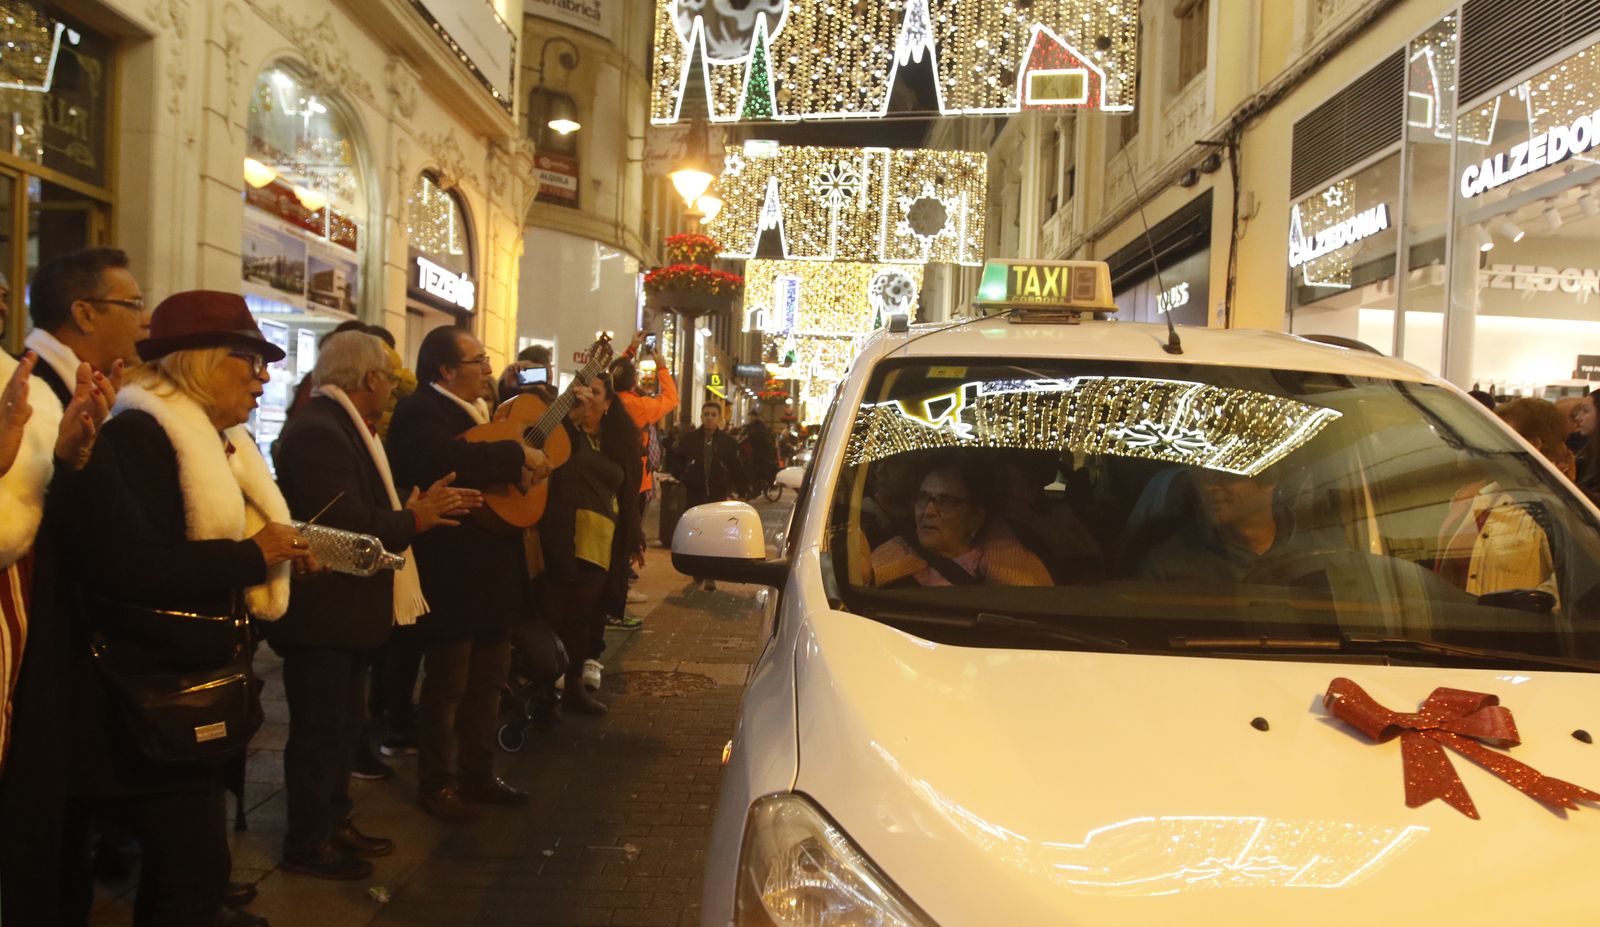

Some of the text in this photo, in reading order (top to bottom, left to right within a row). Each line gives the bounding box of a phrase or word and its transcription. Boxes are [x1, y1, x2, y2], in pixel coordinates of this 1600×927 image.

[540, 171, 569, 185] ALQUILA
[1289, 203, 1388, 268] CALZEDONIA
[1012, 265, 1068, 297] TAXI
[1479, 263, 1600, 294] ZEDON
